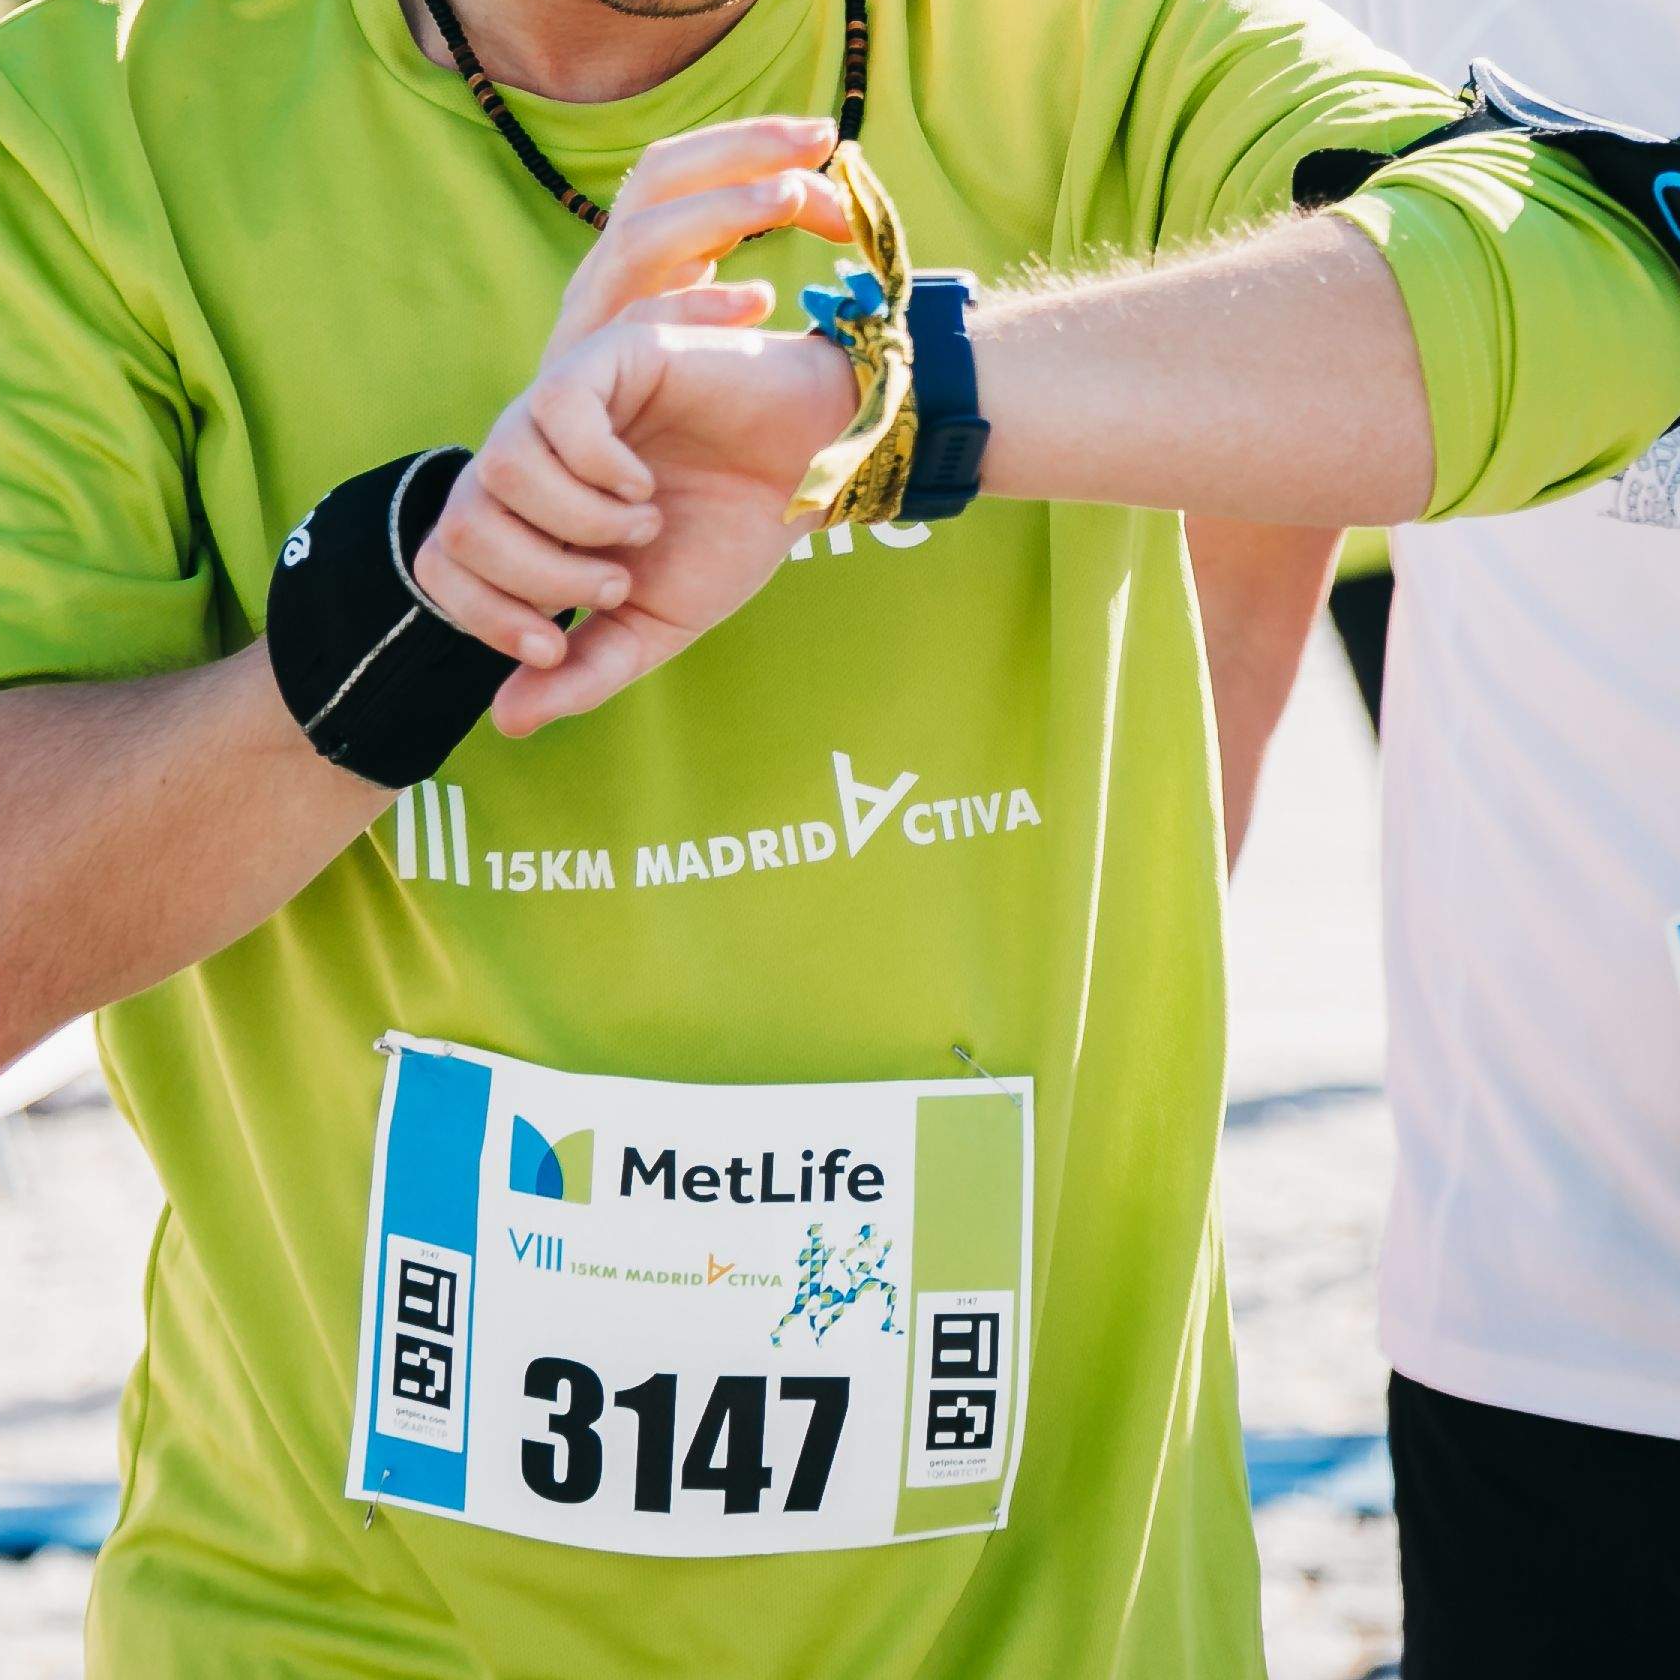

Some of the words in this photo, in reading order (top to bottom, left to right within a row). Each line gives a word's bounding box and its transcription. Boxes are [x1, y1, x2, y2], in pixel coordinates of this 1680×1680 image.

[397, 778, 471, 887] III
[484, 849, 616, 892] 15KM
[634, 820, 837, 889] MADRID
[619, 1146, 886, 1205] MetLife
[508, 1226, 564, 1273] VIII
[570, 1261, 618, 1280] 15KM
[624, 1268, 704, 1287] MADRID
[956, 1296, 979, 1307] 3147
[520, 1355, 852, 1516] 3147
[928, 1457, 988, 1469] getpica.com
